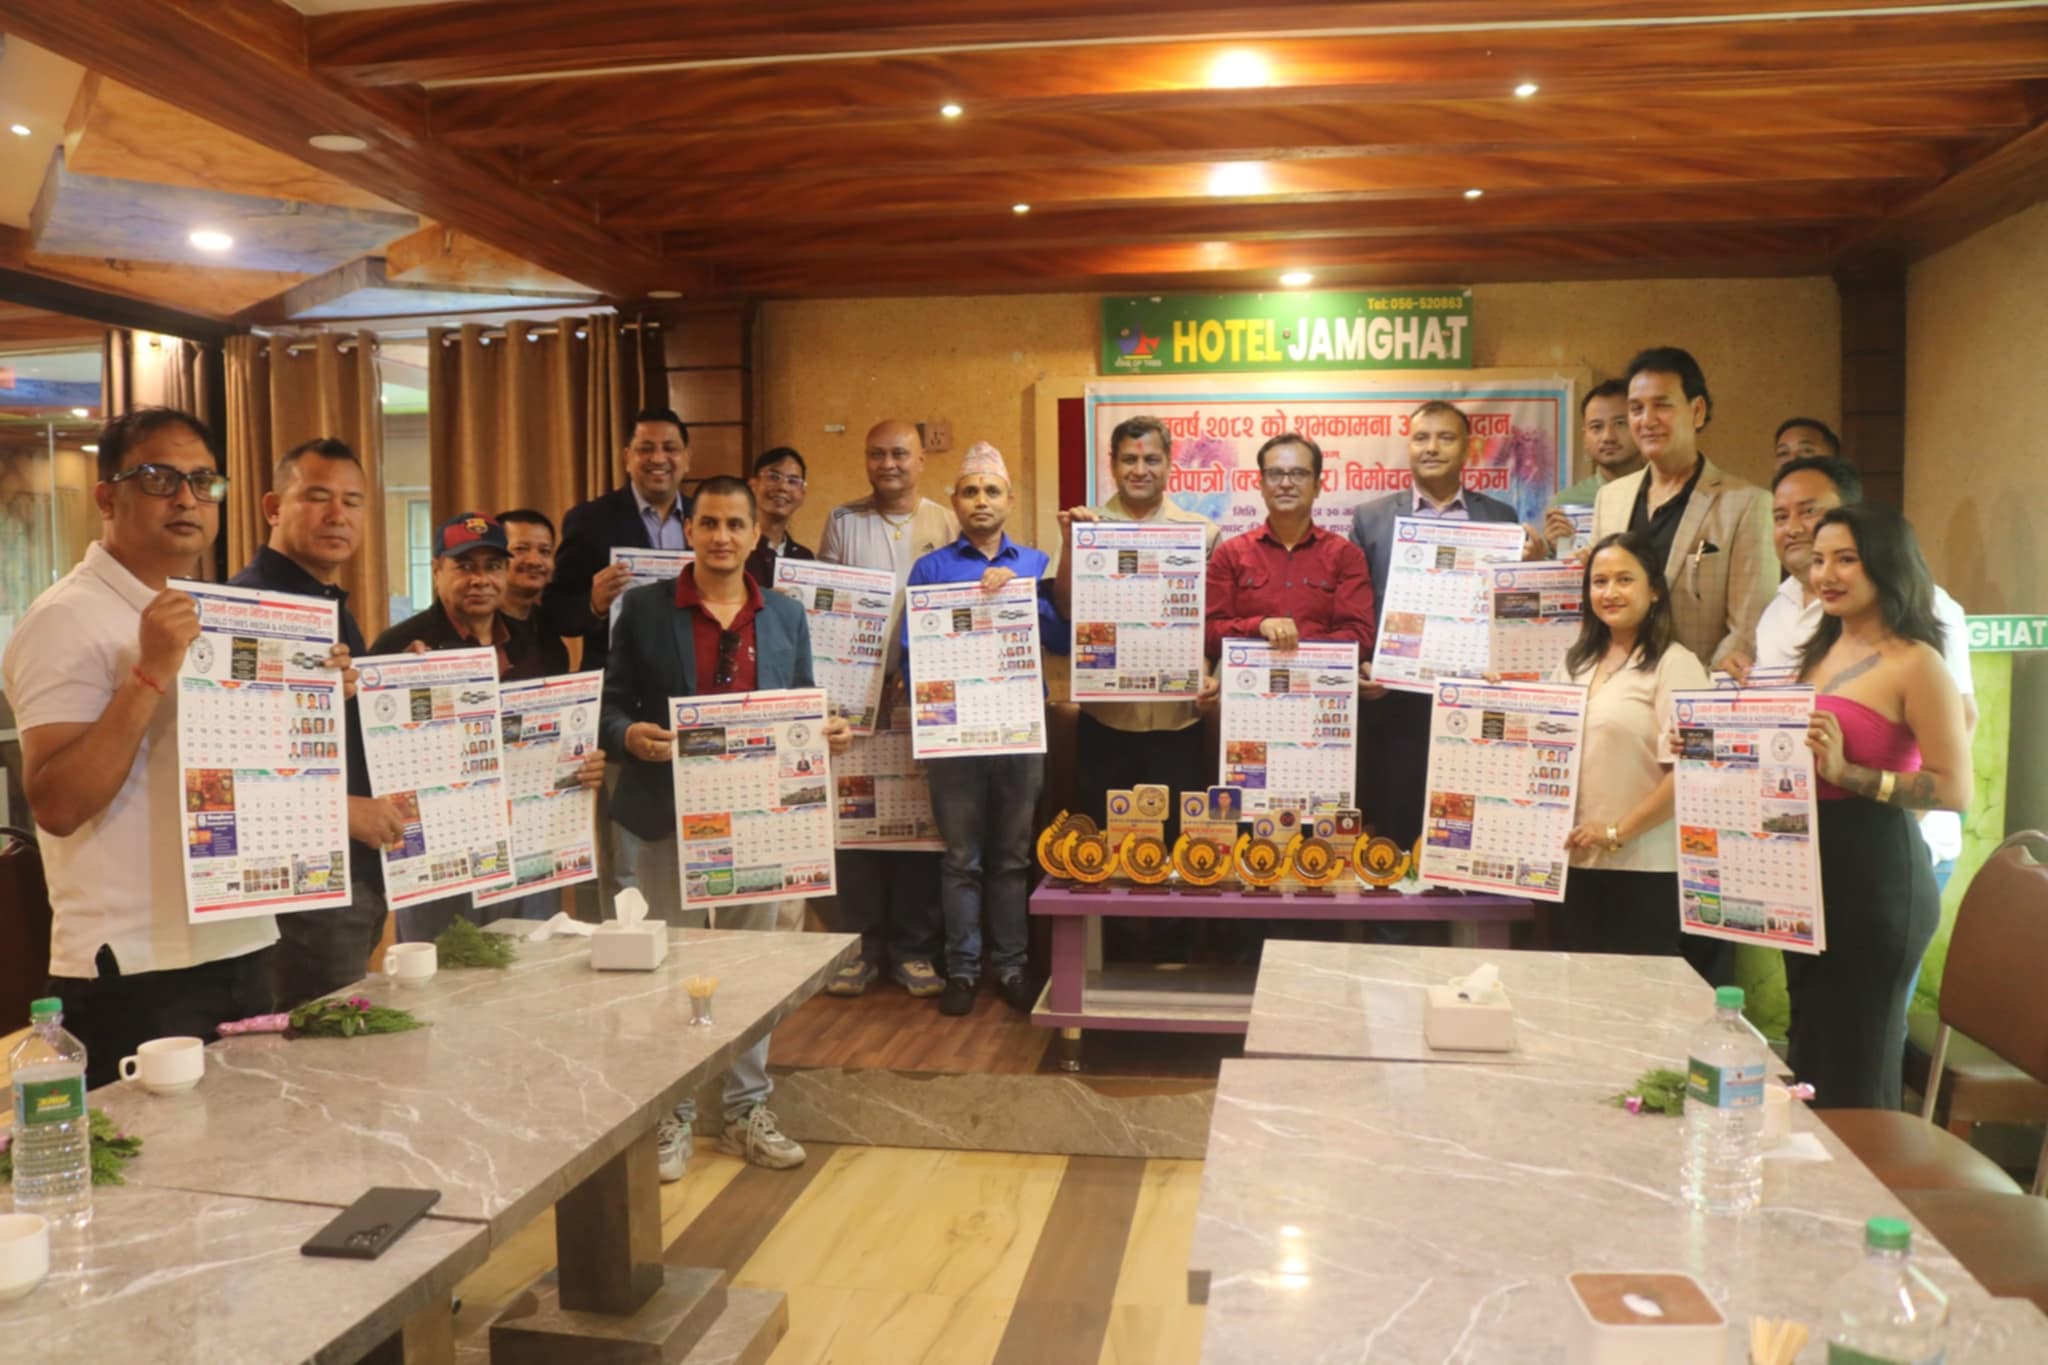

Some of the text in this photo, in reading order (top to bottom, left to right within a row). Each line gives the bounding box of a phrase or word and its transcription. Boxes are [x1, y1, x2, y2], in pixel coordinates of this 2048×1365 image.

[1173, 316, 1468, 363] HOTEL JAMGHAT
[1206, 416, 1254, 437] २०८२
[1261, 409, 1287, 437] को
[1295, 413, 1391, 441] शुभकामना
[1968, 621, 2047, 645] GHAT
